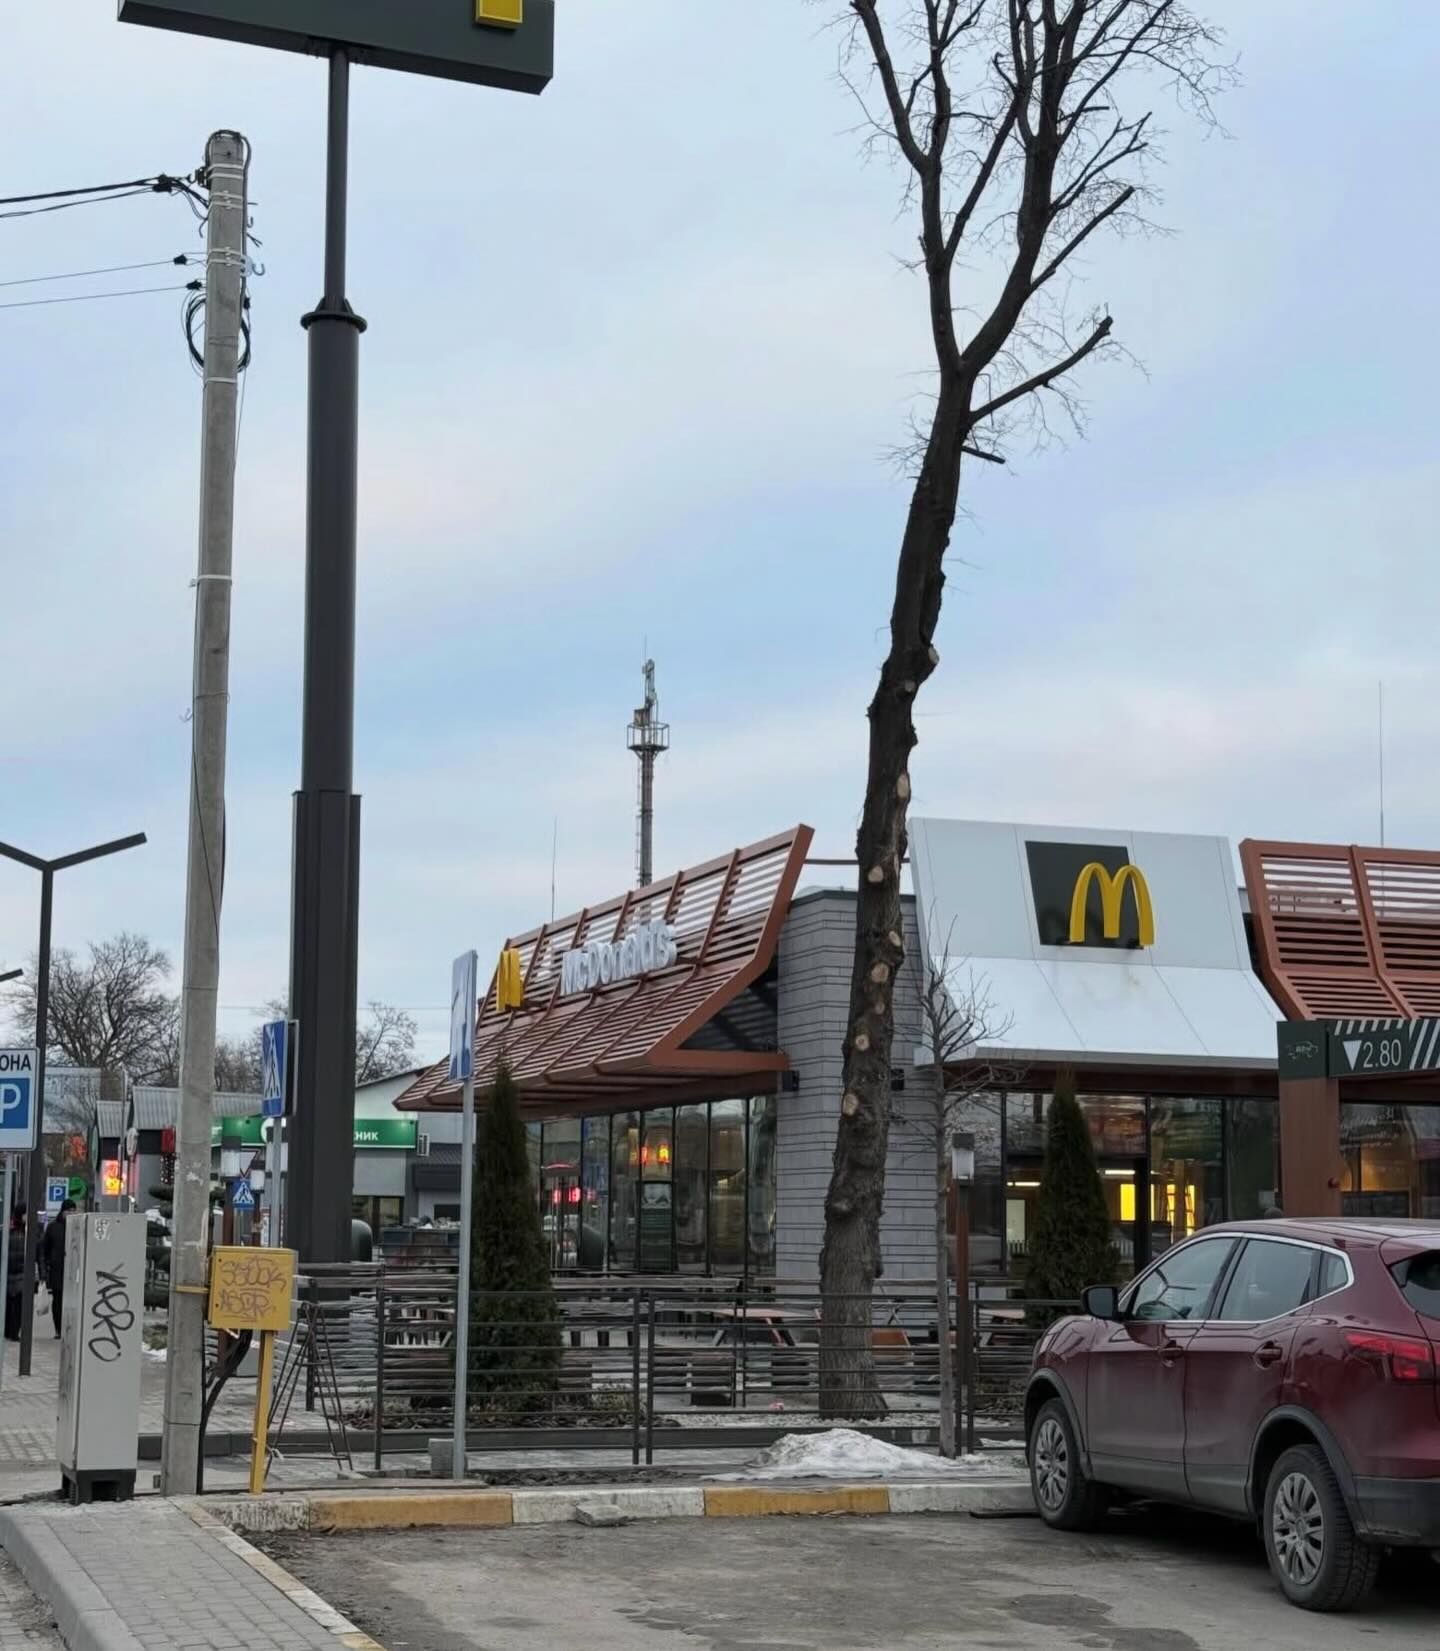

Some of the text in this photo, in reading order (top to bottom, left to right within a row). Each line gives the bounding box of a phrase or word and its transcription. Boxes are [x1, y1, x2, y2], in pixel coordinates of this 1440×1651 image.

[0, 1054, 32, 1071] ОНА
[1363, 1039, 1402, 1069] 2.80
[354, 1131, 379, 1141] НИК
